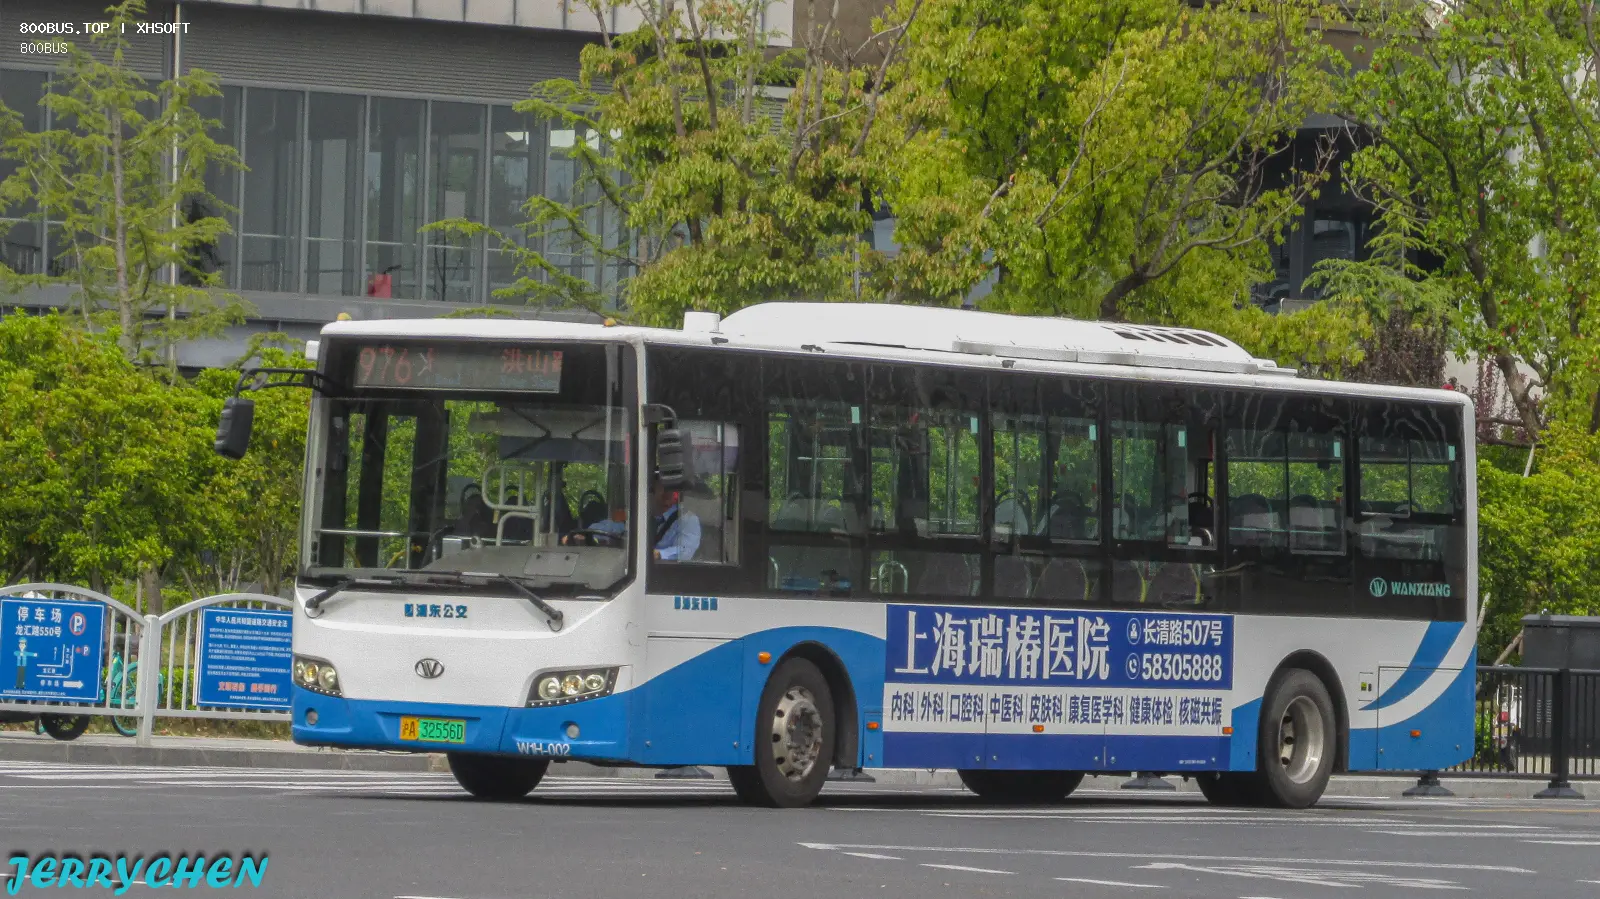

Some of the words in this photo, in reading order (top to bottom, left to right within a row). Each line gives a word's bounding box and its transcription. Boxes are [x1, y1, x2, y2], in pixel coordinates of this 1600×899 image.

[360, 347, 413, 384] 976
[1391, 581, 1451, 598] WANXIANG
[17, 605, 62, 624] 停车场
[1142, 618, 1224, 647] 长清路507号
[894, 610, 1111, 681] 上海瑞椿医院
[1141, 653, 1223, 682] 58305888
[421, 721, 464, 740] 32556D
[516, 741, 571, 757] W1H-002
